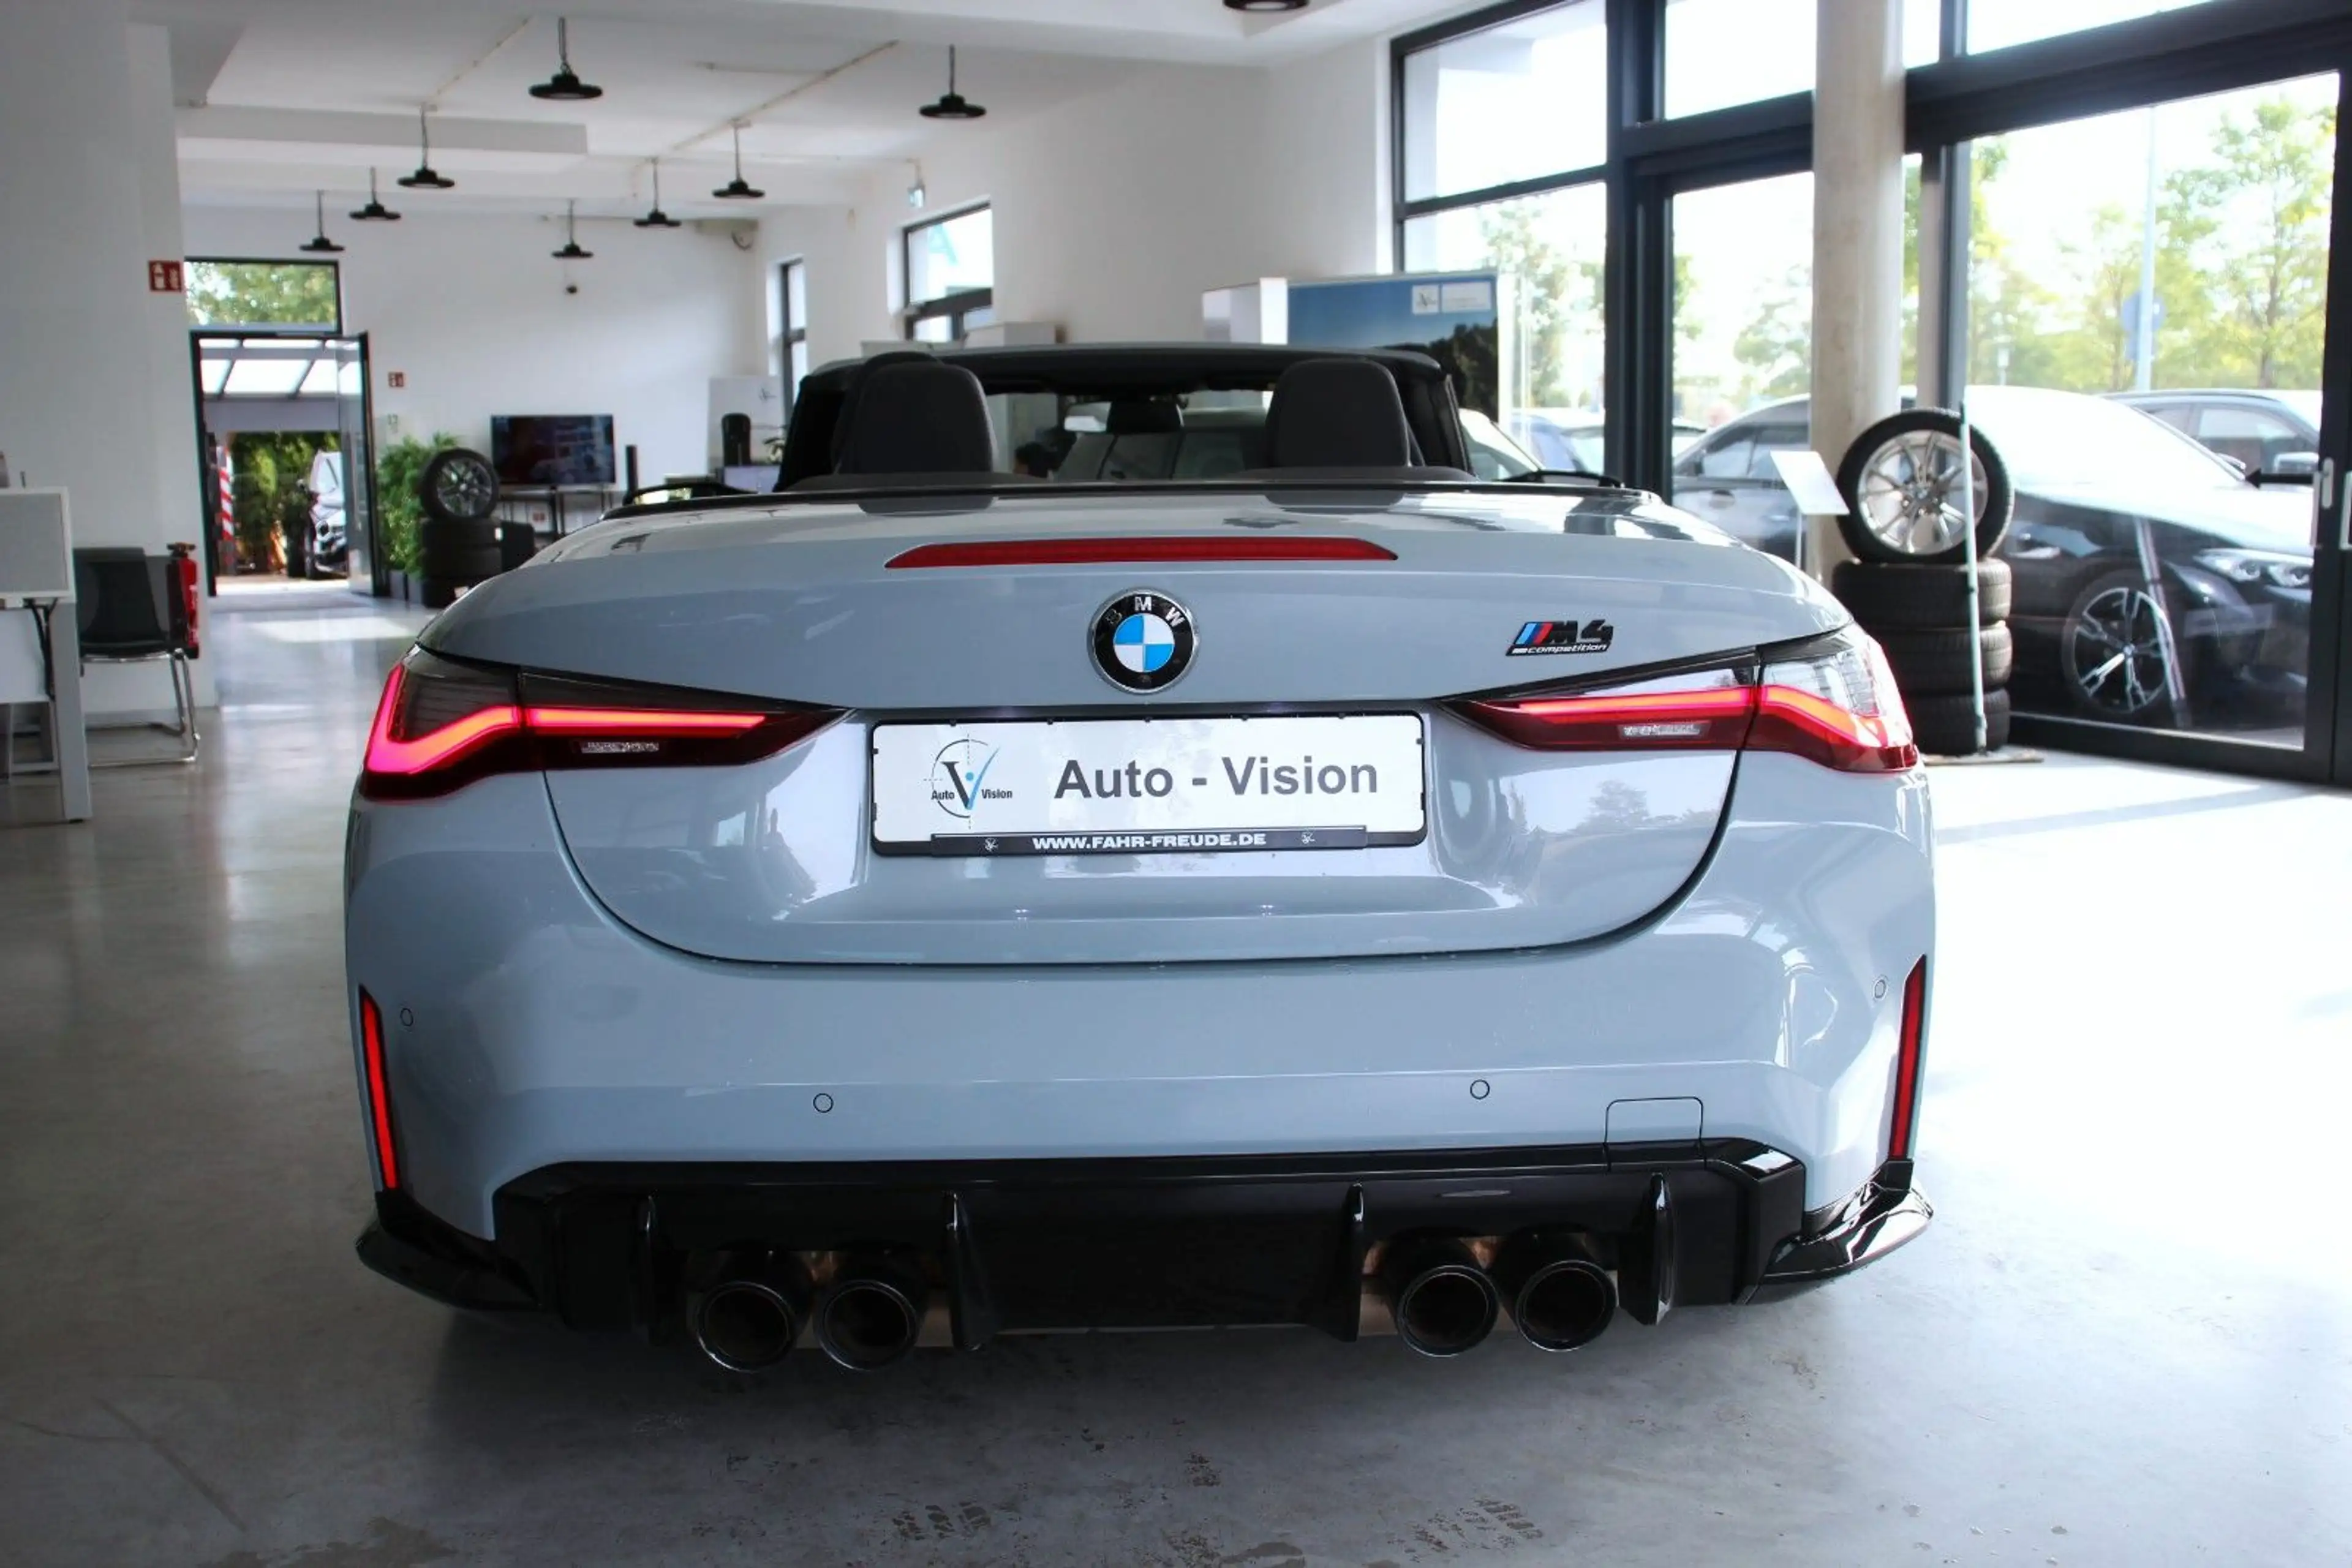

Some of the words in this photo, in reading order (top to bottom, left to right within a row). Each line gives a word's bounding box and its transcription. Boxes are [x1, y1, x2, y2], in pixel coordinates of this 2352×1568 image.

[1106, 597, 1185, 627] BMW
[1528, 644, 1607, 654] competition
[1054, 760, 1173, 799] Auto
[1221, 755, 1378, 796] Vision
[931, 790, 955, 800] Auto
[982, 789, 1012, 799] Vision
[1033, 834, 1267, 850] WWW.FAHR-FREUDE.DE
